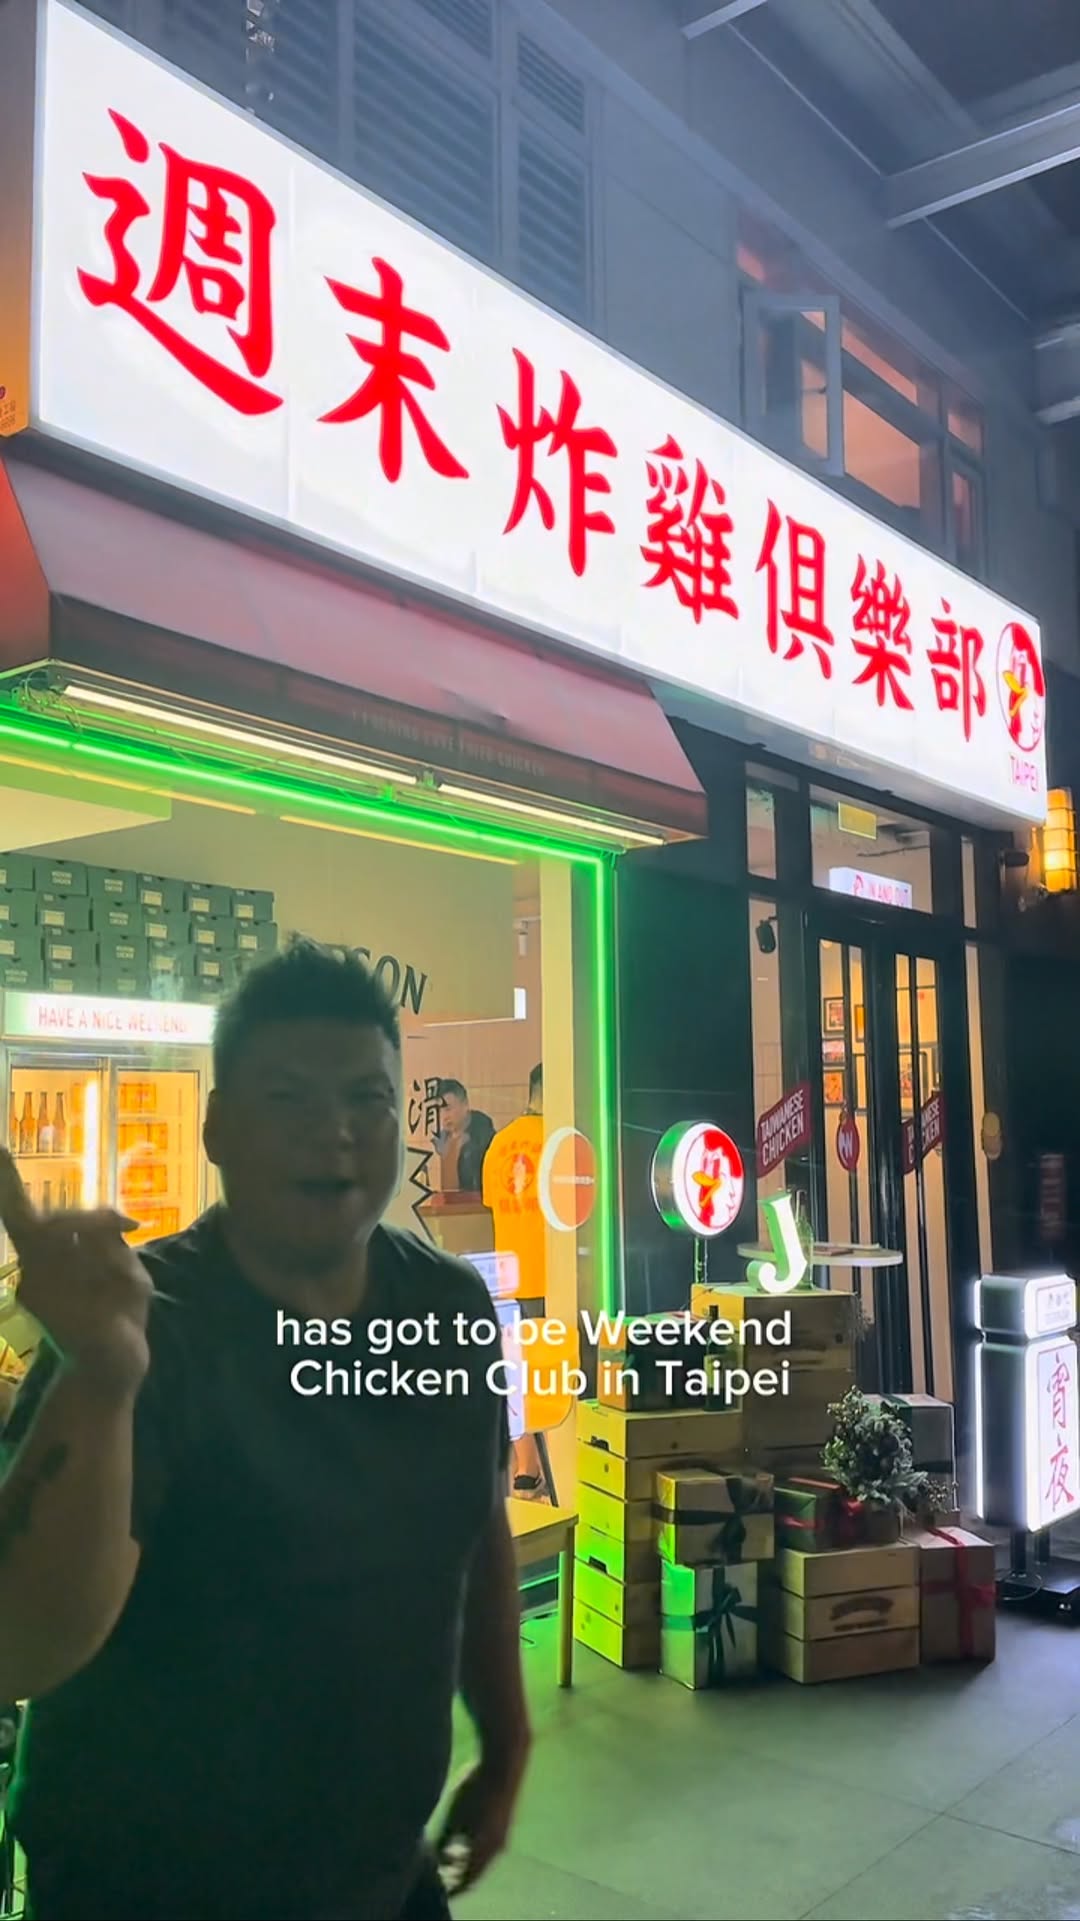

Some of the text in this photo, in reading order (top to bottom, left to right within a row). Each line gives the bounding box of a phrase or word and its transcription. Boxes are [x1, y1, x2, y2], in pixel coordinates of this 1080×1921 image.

[76, 108, 988, 743] 週末炸雞俱樂部
[1009, 754, 1039, 792] TAIPEI
[38, 1005, 74, 1028] HAVE
[78, 1007, 88, 1029] A
[760, 1089, 804, 1142] TAIWANESE
[762, 1111, 804, 1167] CHICKEN
[1046, 1352, 1075, 1512] 宵夜
